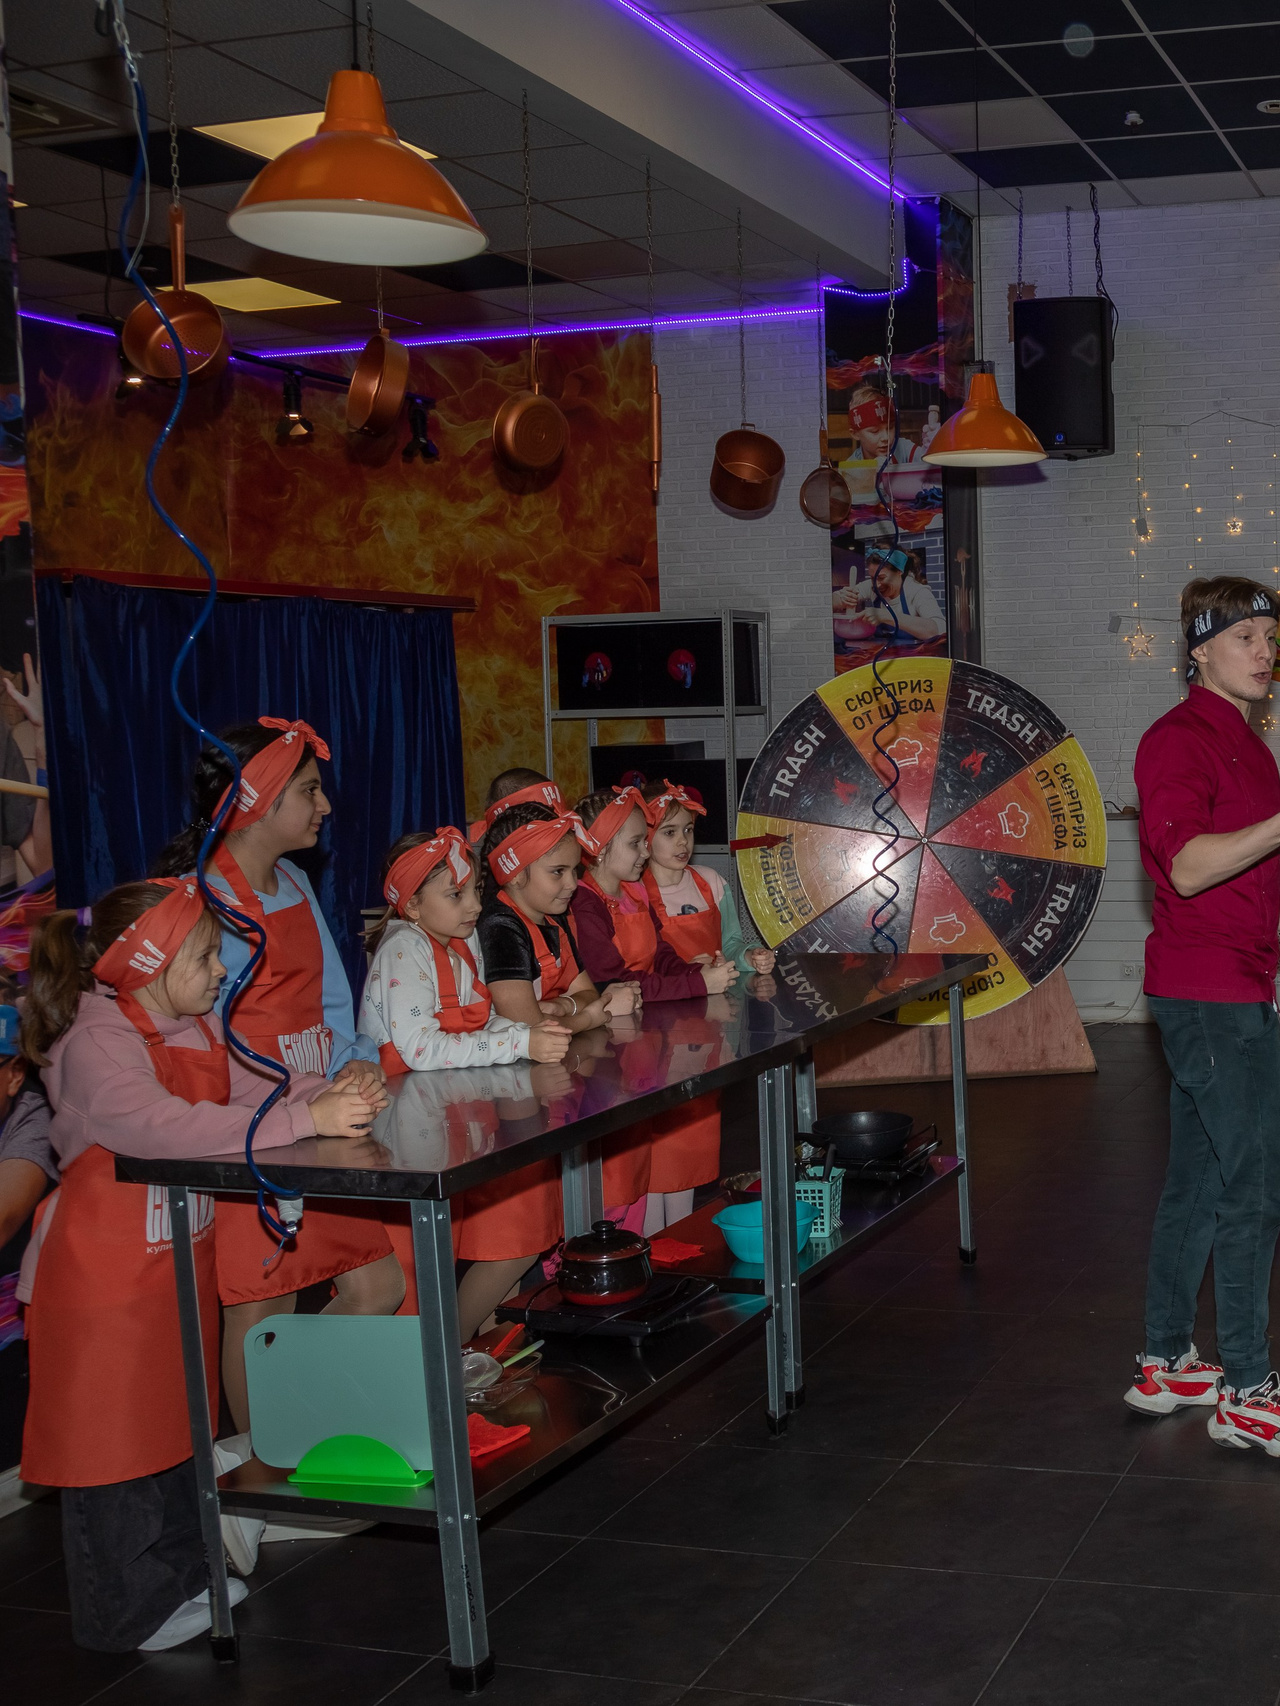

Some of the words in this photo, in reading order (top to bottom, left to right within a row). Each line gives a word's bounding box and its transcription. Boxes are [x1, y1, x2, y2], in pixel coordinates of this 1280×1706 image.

[845, 680, 934, 712] СЮРПРИЗ
[852, 709, 876, 731] ОТ
[879, 699, 936, 720] ШЕФА
[966, 688, 1041, 745] TRASH
[769, 721, 826, 801] TRASH
[1034, 770, 1055, 796] ОТ
[1046, 798, 1069, 852] ШЕФА
[1053, 762, 1087, 849] СЮРПРИЗ
[497, 847, 521, 876] C&R
[759, 846, 794, 925] СЮРПРИ
[792, 894, 813, 917] ОТ
[1021, 882, 1076, 957] TRASH
[128, 938, 167, 975] C&R
